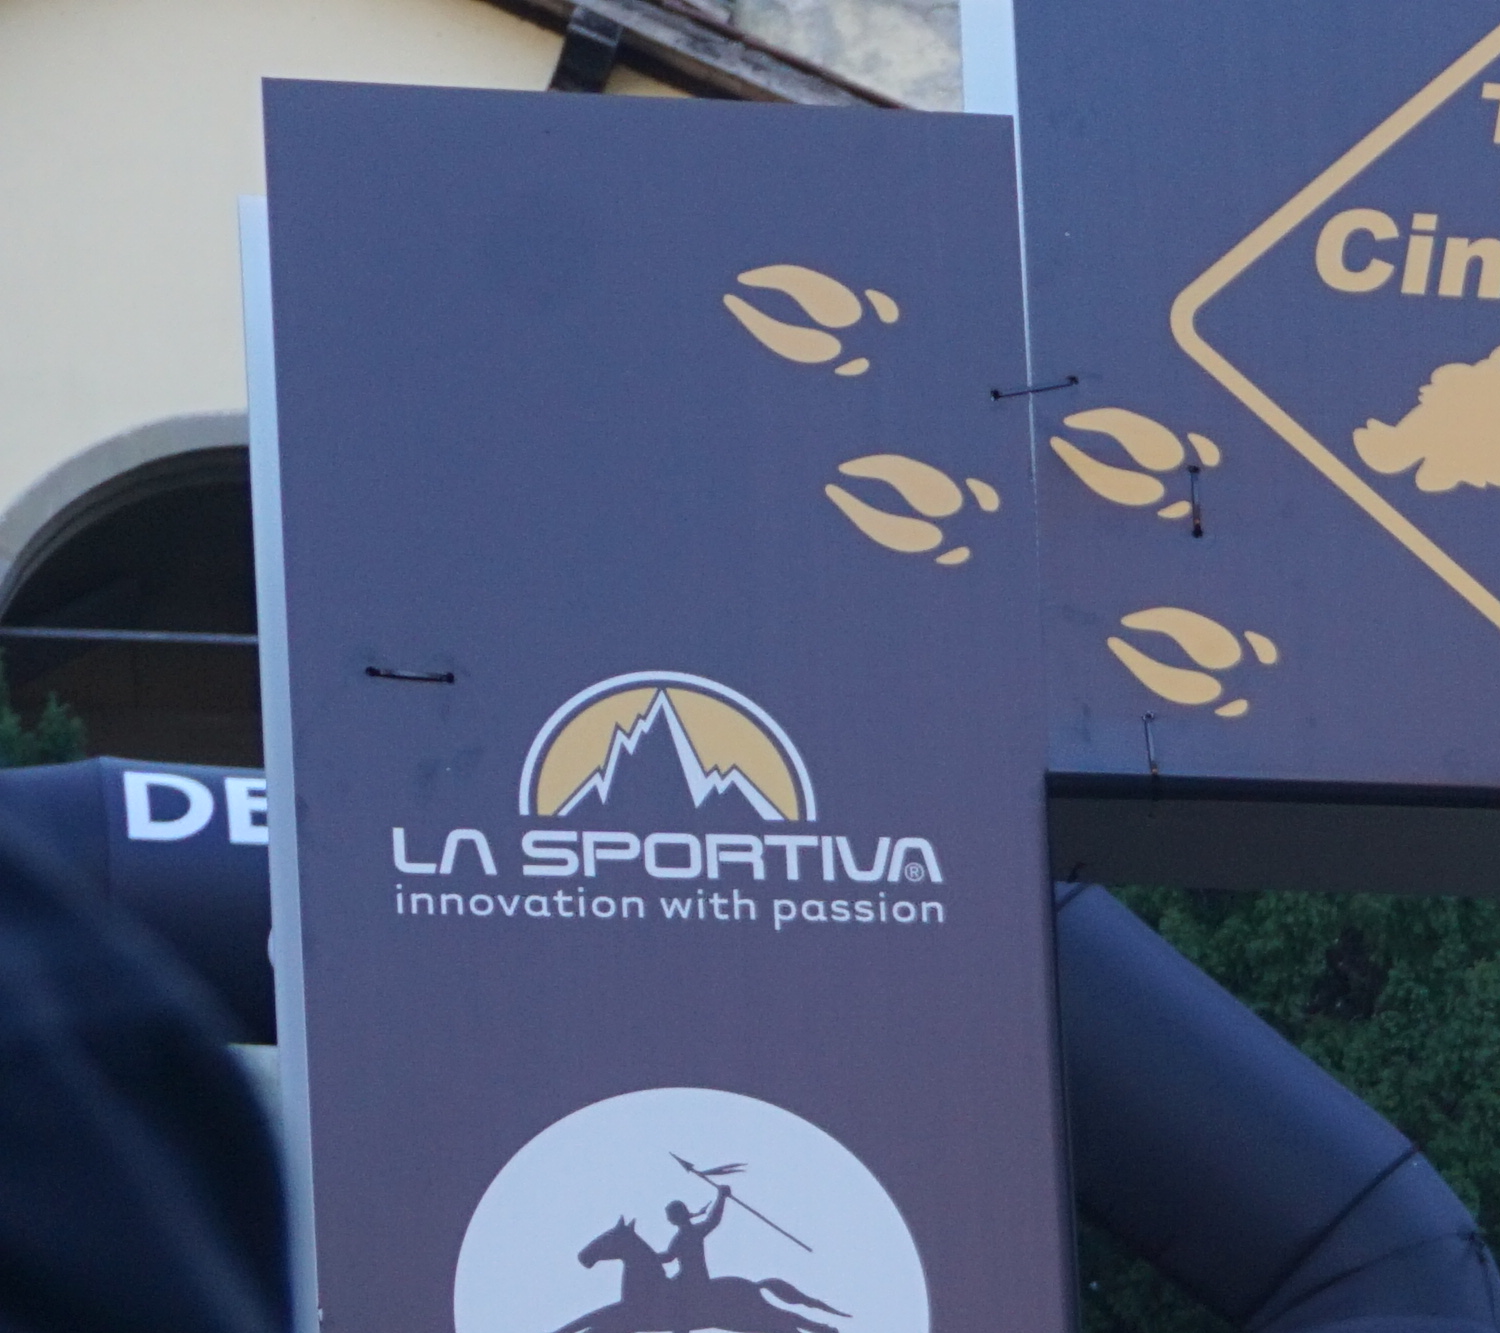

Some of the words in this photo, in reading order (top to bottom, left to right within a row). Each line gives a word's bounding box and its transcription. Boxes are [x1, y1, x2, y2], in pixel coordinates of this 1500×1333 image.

[391, 826, 497, 876] LA
[395, 883, 647, 919] innovation
[662, 888, 757, 921] with
[771, 892, 944, 930] passion
